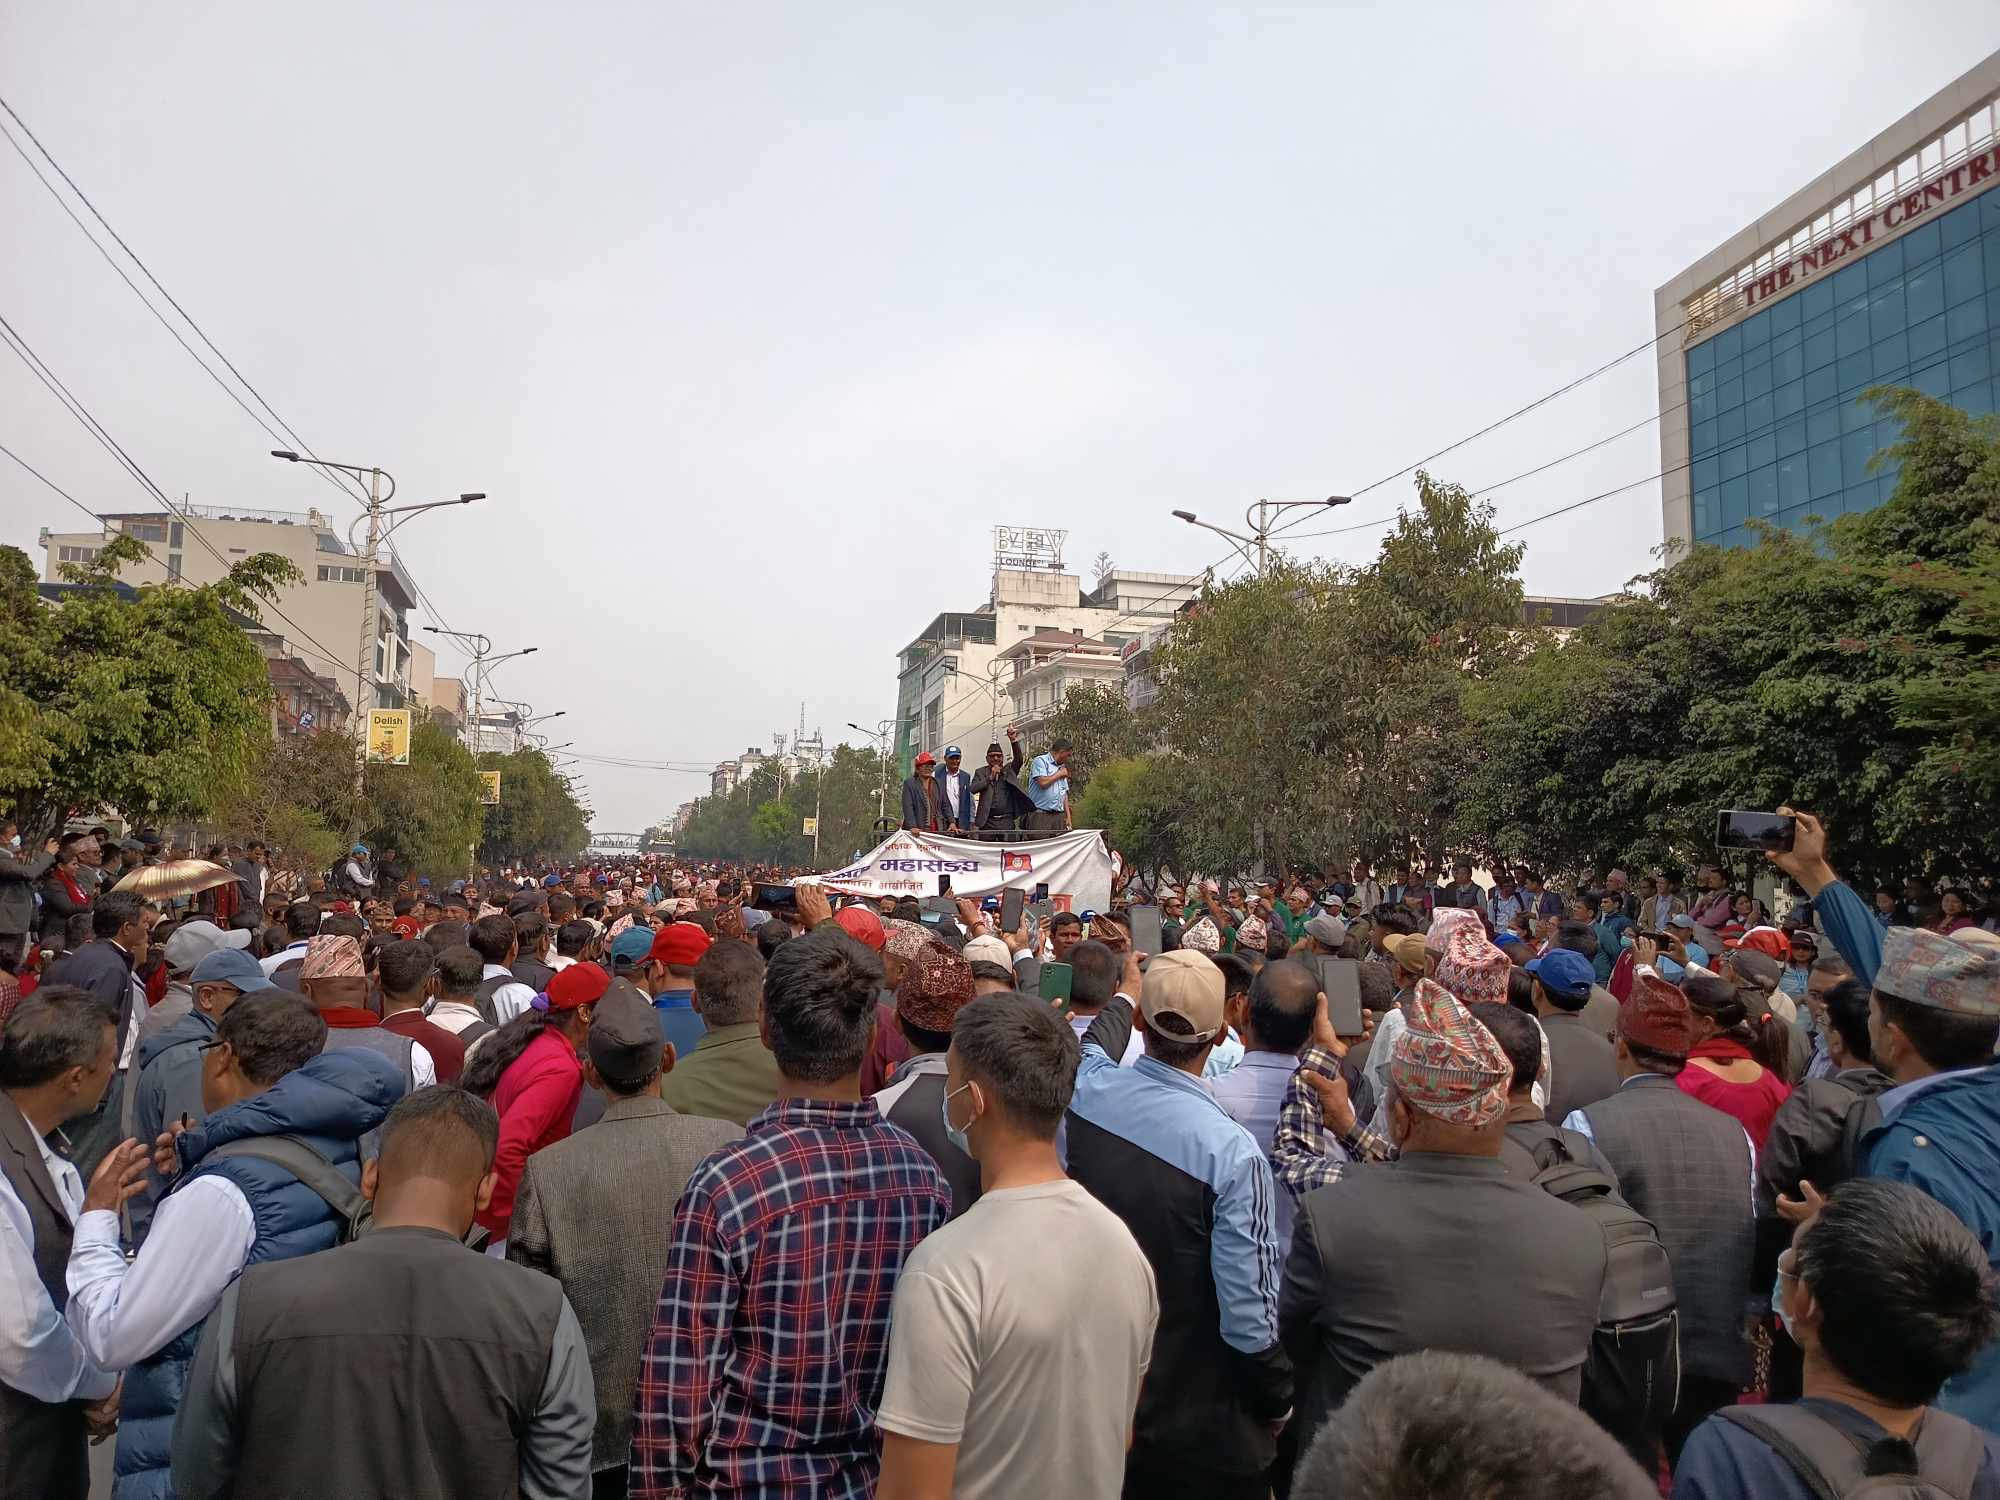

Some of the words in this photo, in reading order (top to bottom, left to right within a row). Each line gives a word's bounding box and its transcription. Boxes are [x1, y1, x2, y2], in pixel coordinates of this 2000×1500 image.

[1742, 262, 1795, 307] THE
[1801, 214, 1877, 277] NEXT
[994, 525, 1069, 557] BEY
